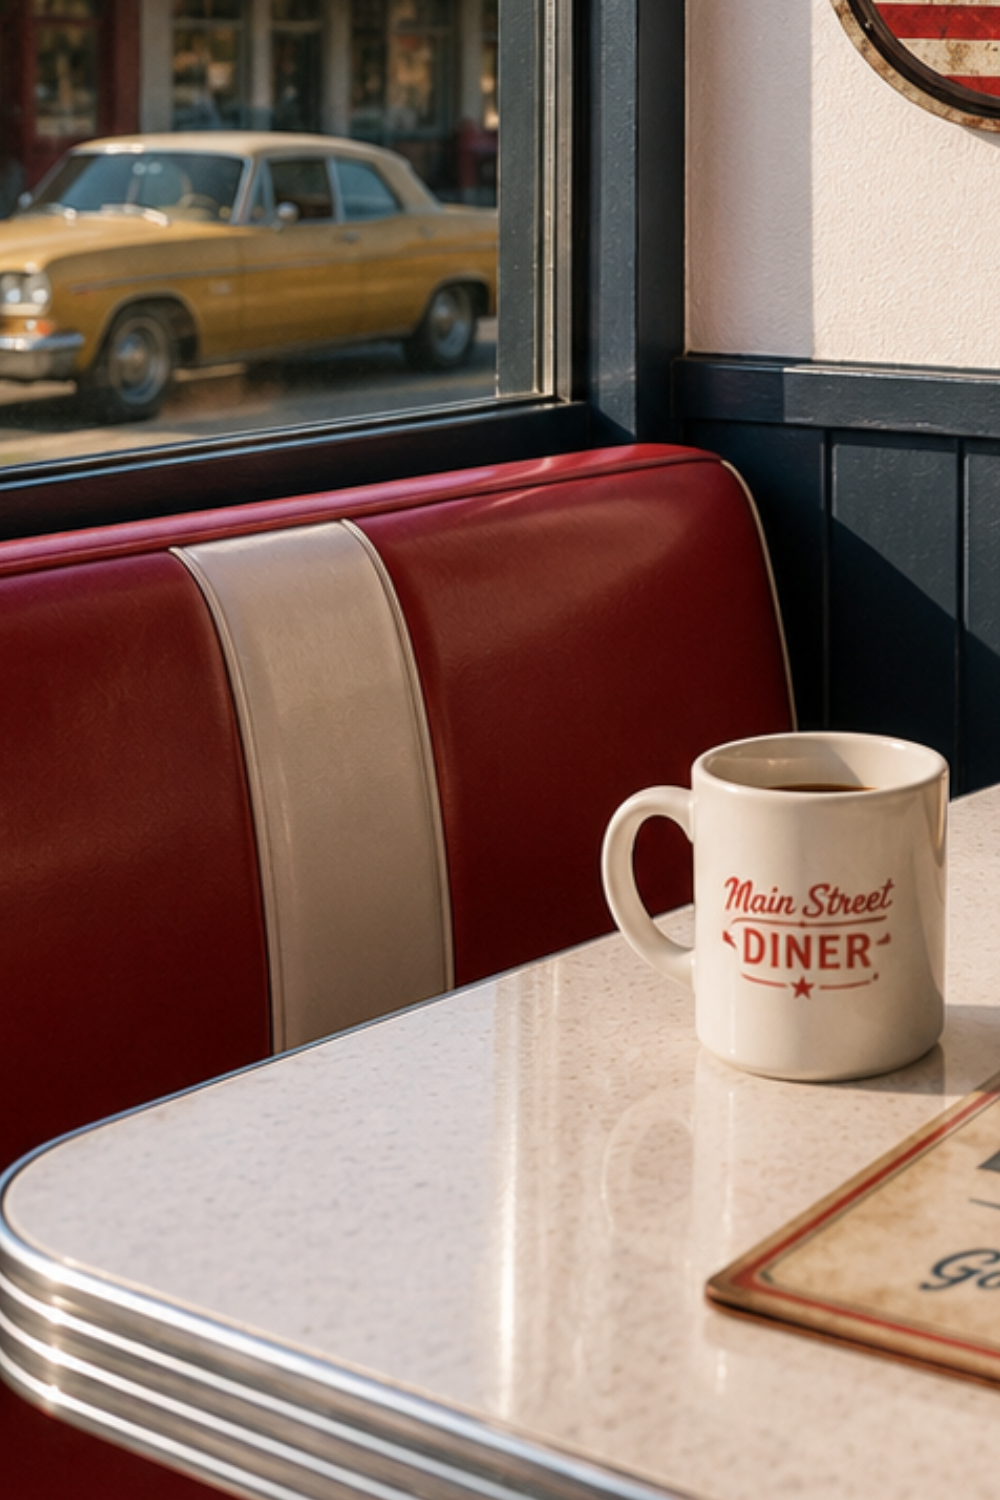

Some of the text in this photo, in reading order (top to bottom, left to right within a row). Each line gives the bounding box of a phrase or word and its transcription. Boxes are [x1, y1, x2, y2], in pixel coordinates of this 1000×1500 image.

[724, 876, 894, 918] Main Street
[743, 928, 871, 969] DINER
